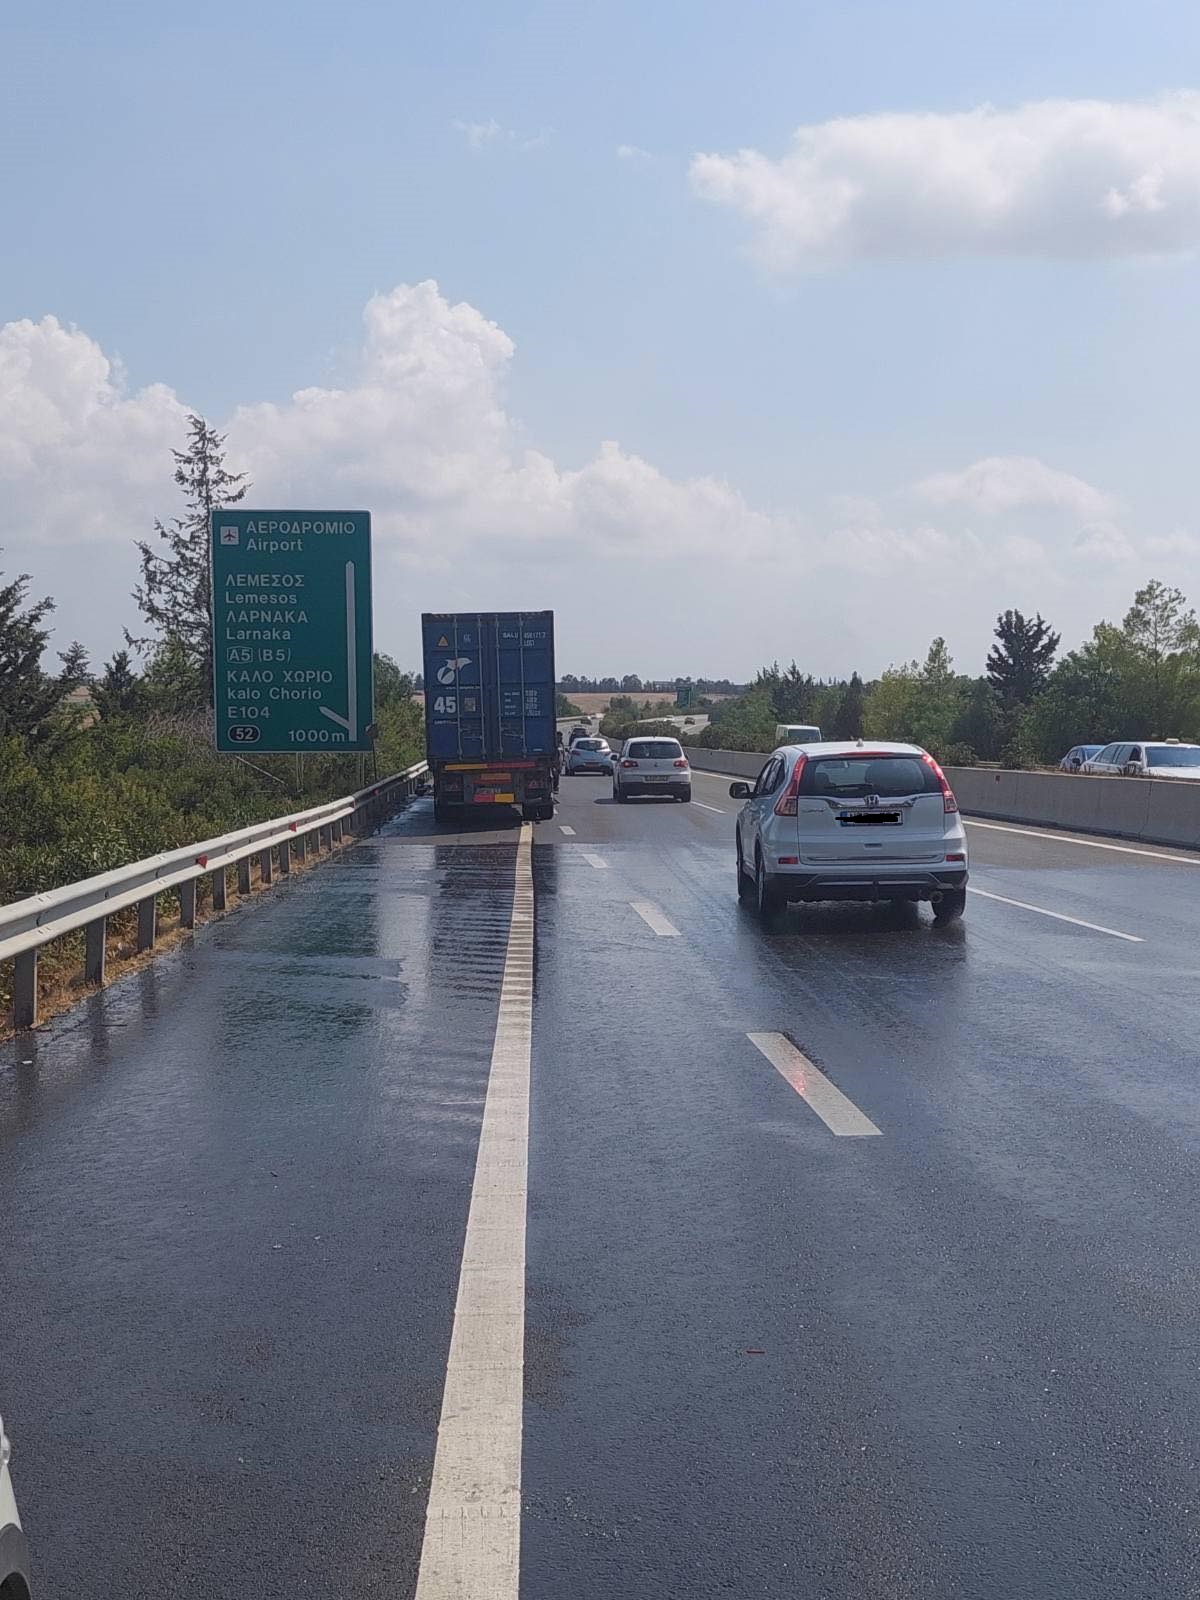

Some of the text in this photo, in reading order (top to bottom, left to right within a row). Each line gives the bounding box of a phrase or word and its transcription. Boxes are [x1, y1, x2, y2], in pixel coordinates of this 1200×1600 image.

[246, 520, 356, 535] ΑΕΡΟΔΡΟΜΙΟ
[246, 538, 303, 553] Airport
[225, 574, 305, 587] ΛΕΜΕΣΟΣ
[225, 591, 297, 604] Lemesos
[226, 610, 309, 623] ΛΑΡΝΑΚΑ
[226, 628, 291, 640] Larnaka
[229, 648, 292, 662] A5 (B5)
[226, 670, 333, 683] ΚΑΛΟ ΧΩΡΙΟ
[227, 687, 322, 700] kalo Chorio
[434, 696, 456, 714] 45
[227, 706, 271, 719] E104
[235, 728, 254, 740] 52
[288, 730, 345, 742] 1000 m
